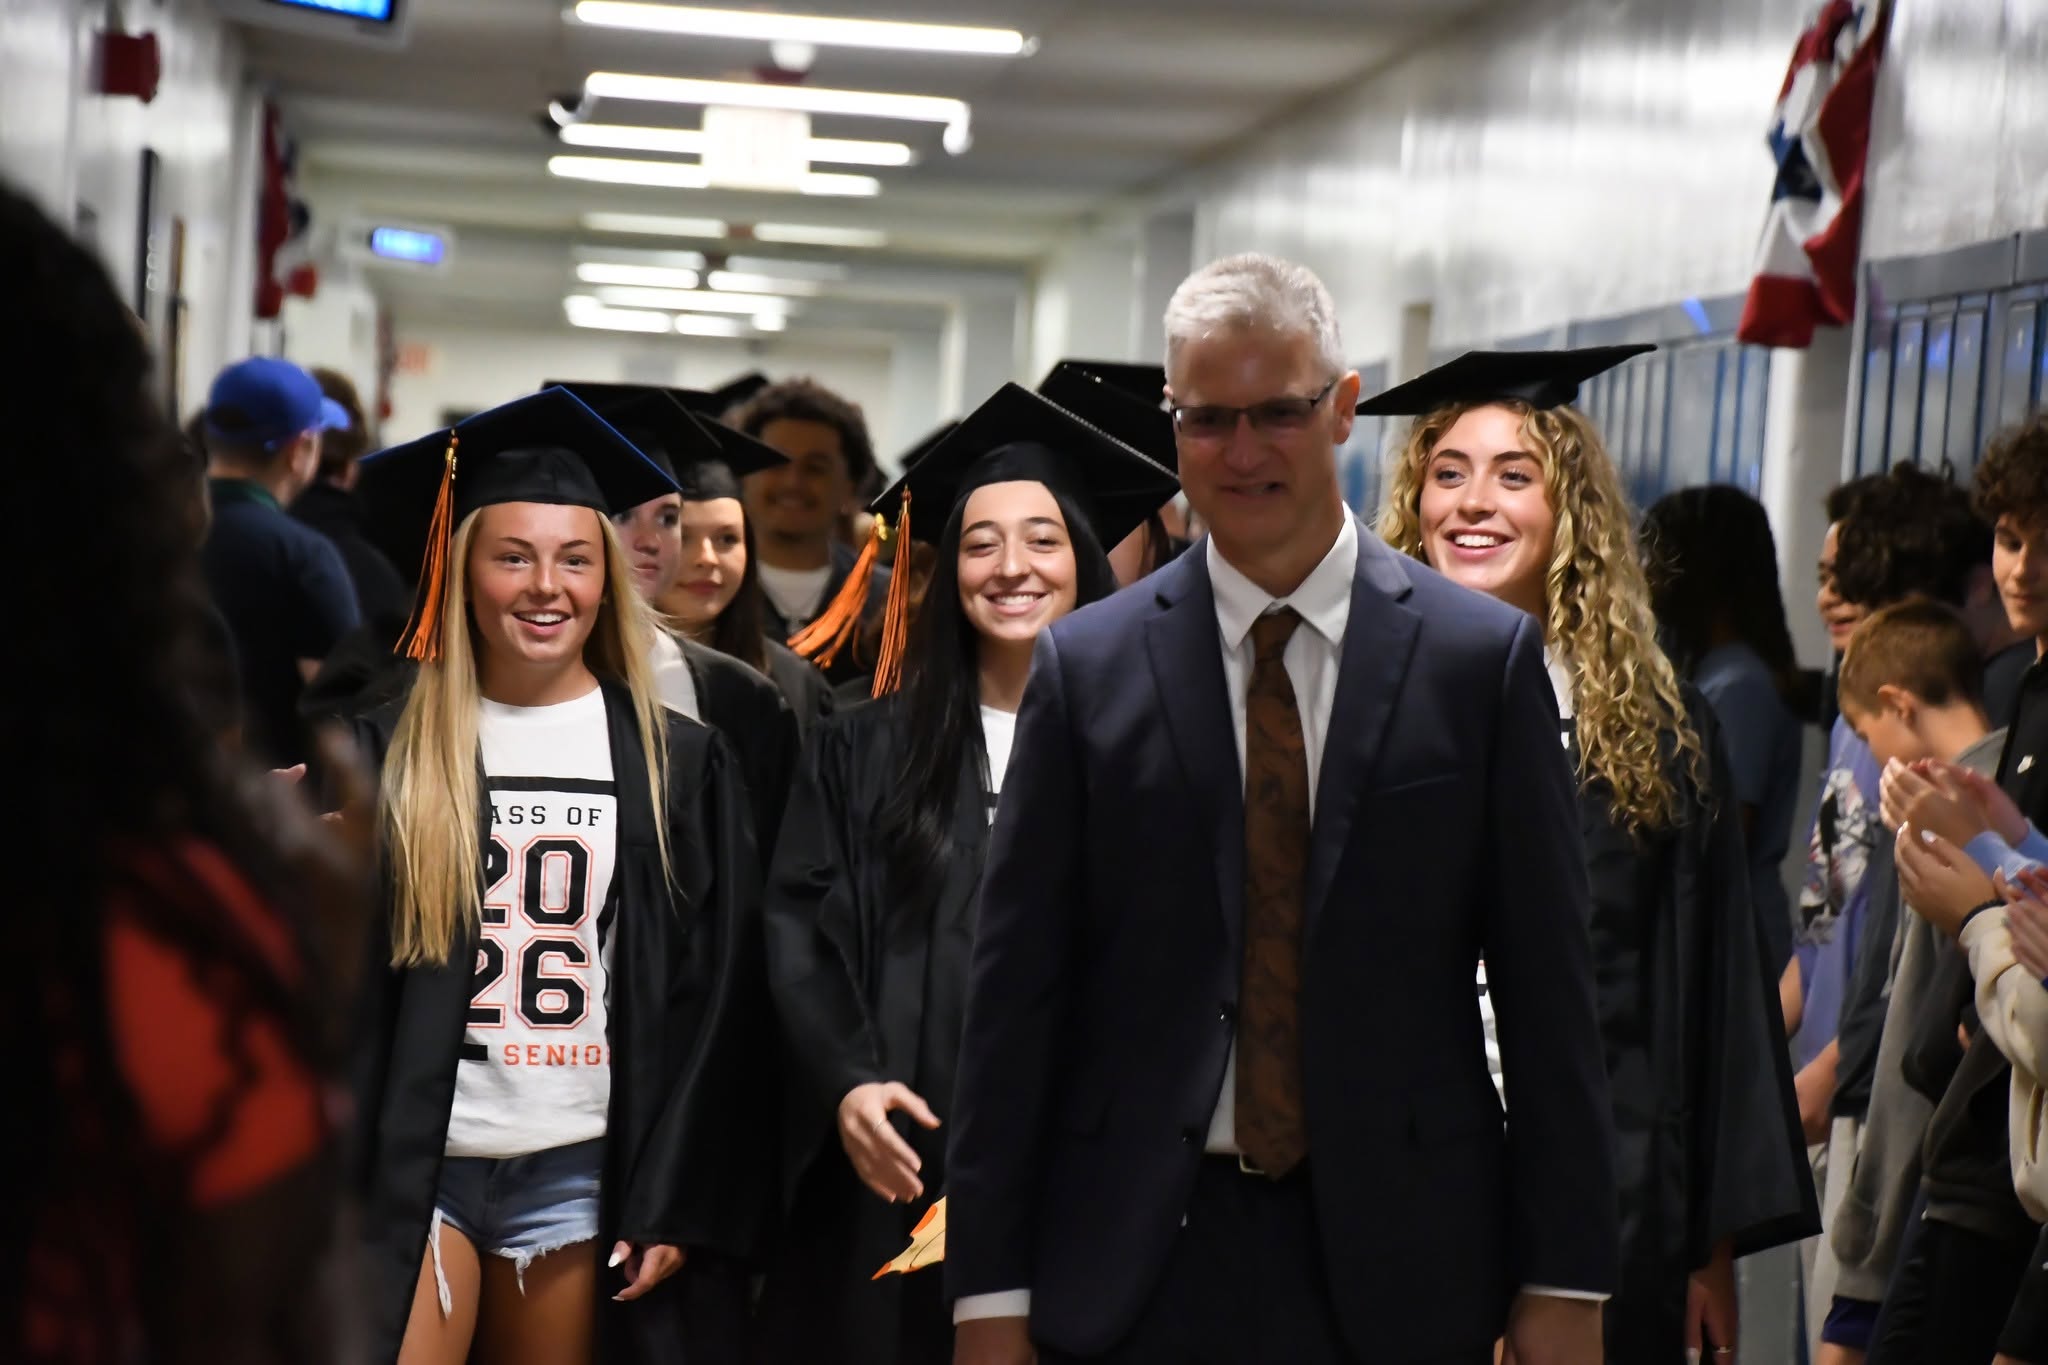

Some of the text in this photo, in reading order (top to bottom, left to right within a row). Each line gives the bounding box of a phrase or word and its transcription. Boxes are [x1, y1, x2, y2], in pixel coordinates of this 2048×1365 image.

[491, 805, 602, 827] ASS OF
[503, 1044, 611, 1066] SENIO
